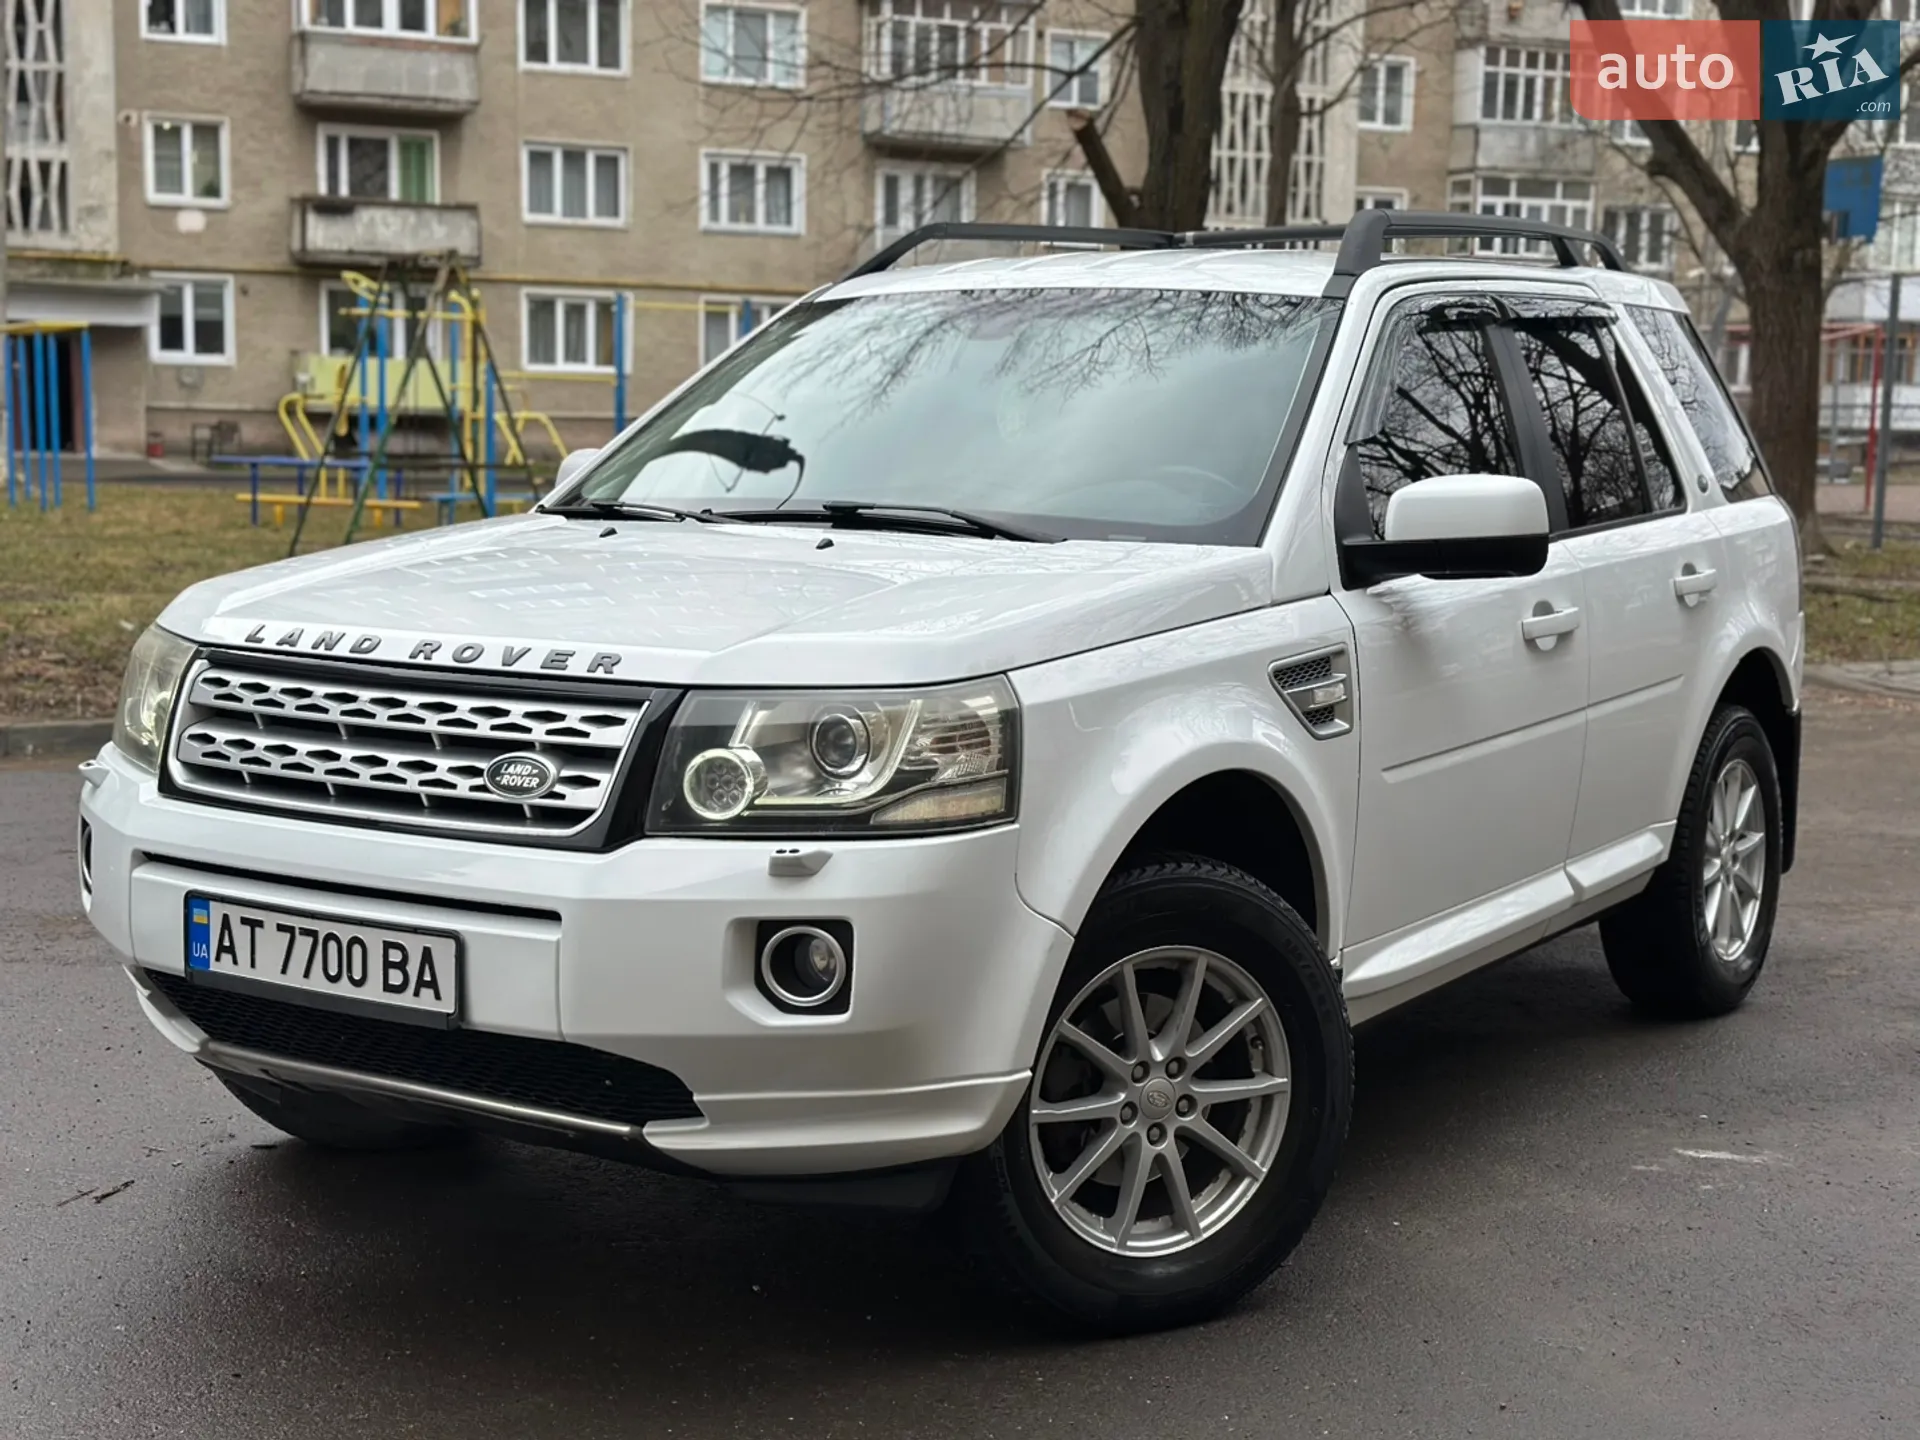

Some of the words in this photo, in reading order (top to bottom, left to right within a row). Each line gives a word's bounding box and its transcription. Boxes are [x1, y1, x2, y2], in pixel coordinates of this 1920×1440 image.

[245, 624, 382, 654] LAND
[409, 639, 622, 675] ROVER
[501, 763, 532, 776] LAND
[501, 775, 540, 788] ROVER
[193, 943, 208, 959] UA
[215, 913, 264, 969] AT
[276, 923, 368, 988] 7700
[382, 940, 442, 1001] BA
